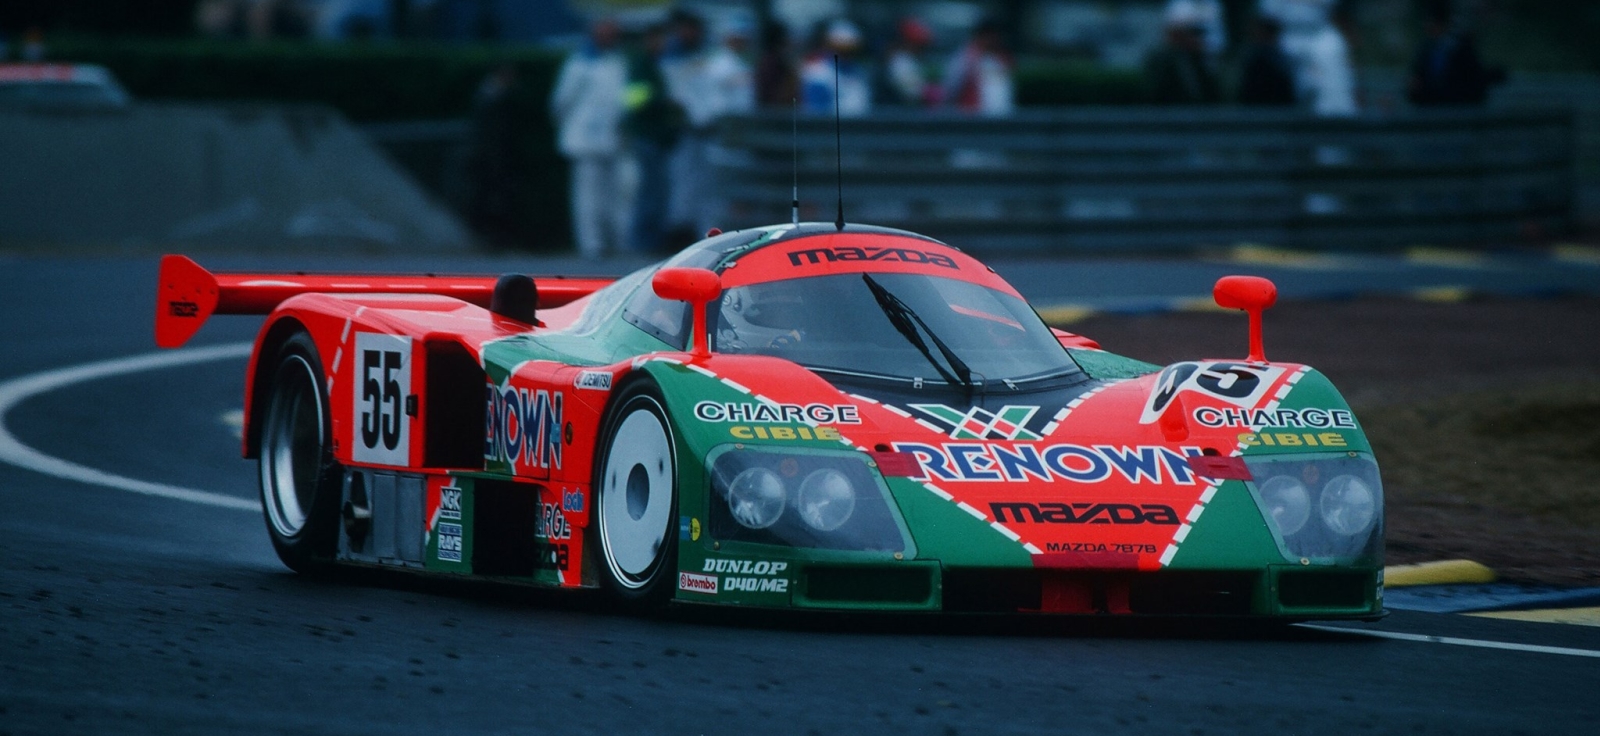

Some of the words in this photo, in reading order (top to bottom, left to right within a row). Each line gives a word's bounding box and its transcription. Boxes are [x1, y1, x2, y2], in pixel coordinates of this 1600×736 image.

[787, 247, 960, 269] mazda
[361, 350, 402, 450] 55
[694, 401, 862, 424] CHARGE
[1194, 407, 1357, 429] CHARGE
[891, 442, 1225, 486] RENOWN
[441, 488, 461, 511] NGK
[988, 502, 1181, 525] mazda
[438, 534, 461, 551] RAYS
[1046, 542, 1107, 553] MAZDA
[703, 558, 787, 575] DUNLOP
[687, 575, 716, 590] brembo
[724, 577, 788, 592] D40/M2
